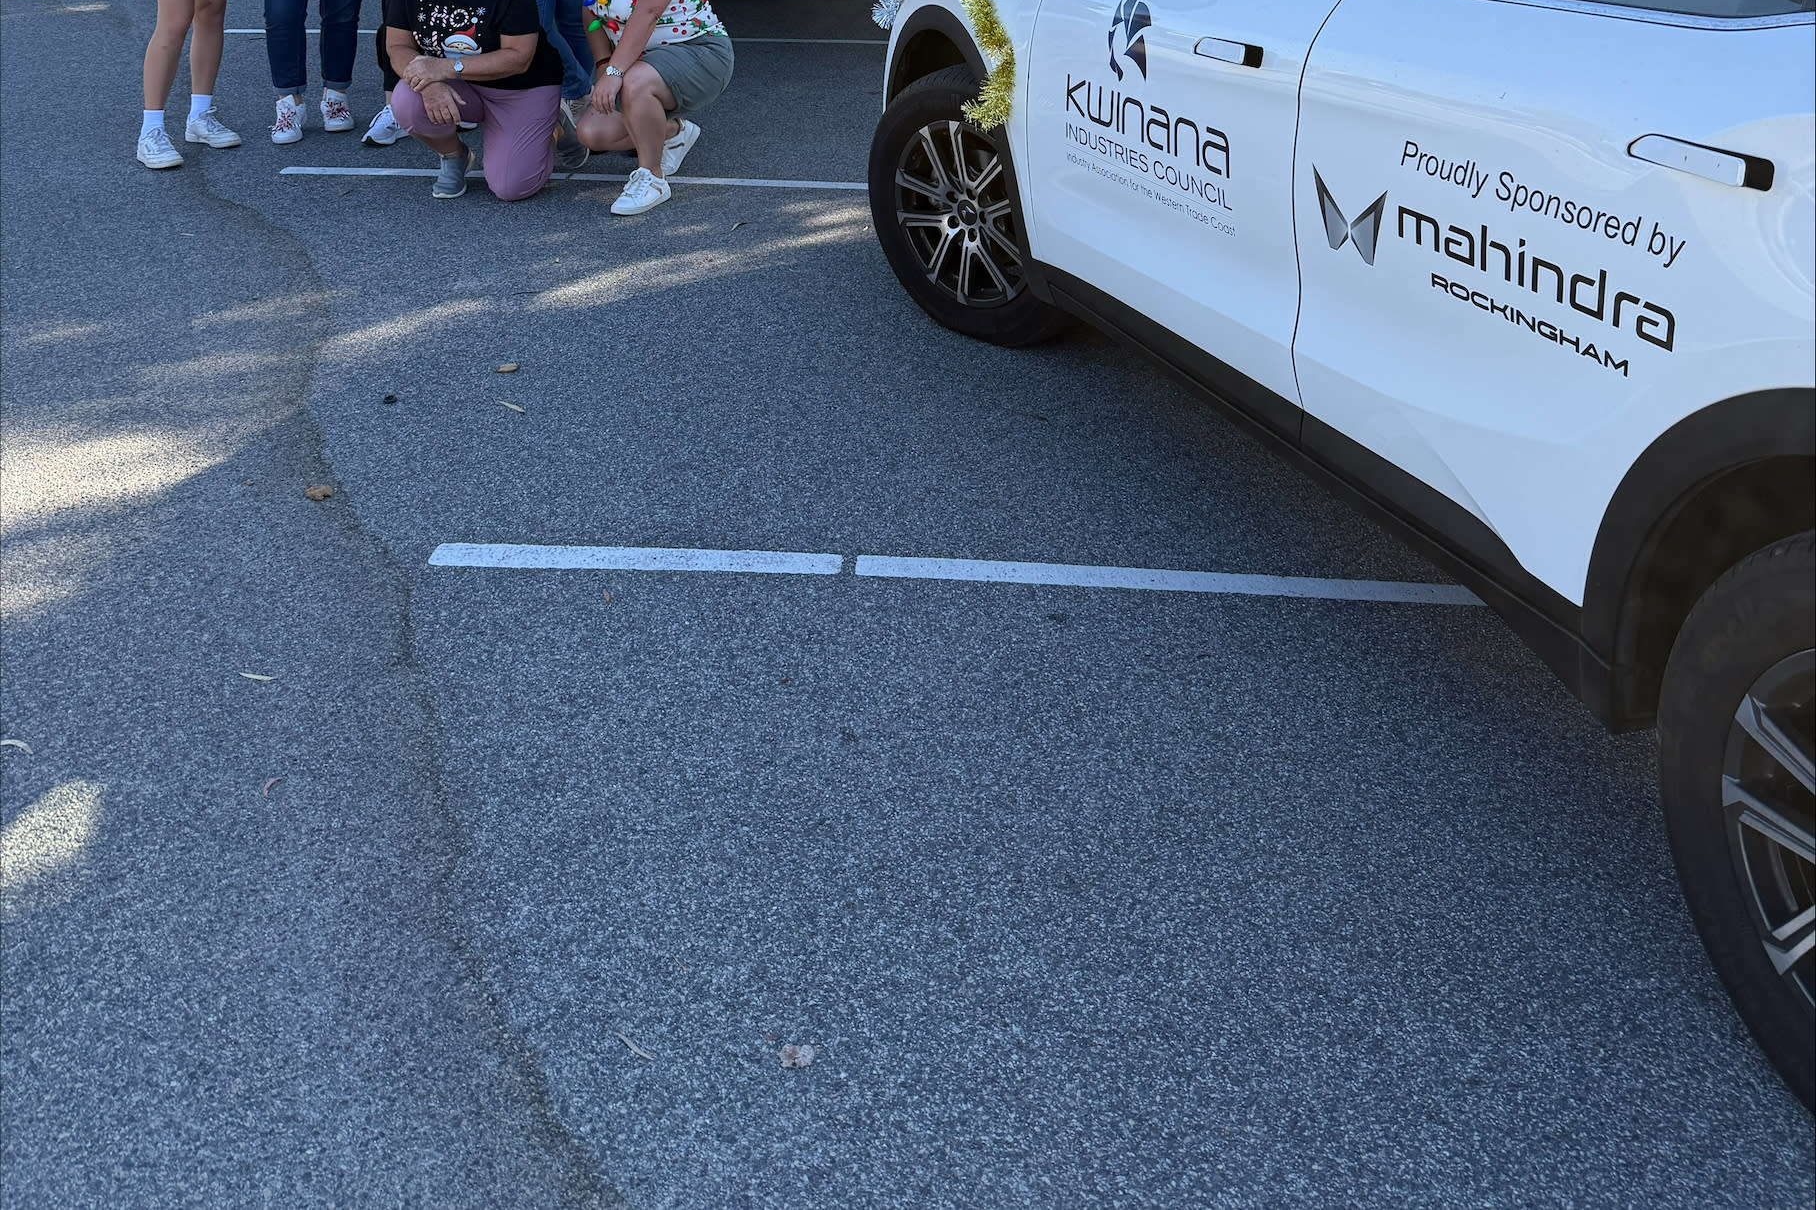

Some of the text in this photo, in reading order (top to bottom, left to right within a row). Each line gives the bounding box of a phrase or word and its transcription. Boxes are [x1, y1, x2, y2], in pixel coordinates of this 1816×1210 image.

[1065, 122, 1233, 212] INDUSTRIES COUNCIL
[1066, 151, 1236, 237] Industry Association for the Western Trade Coast
[1400, 140, 1686, 268] Proudly Sponsored by
[1398, 205, 1676, 353] mahindra
[1431, 272, 1629, 378] ROCKINGHAM
